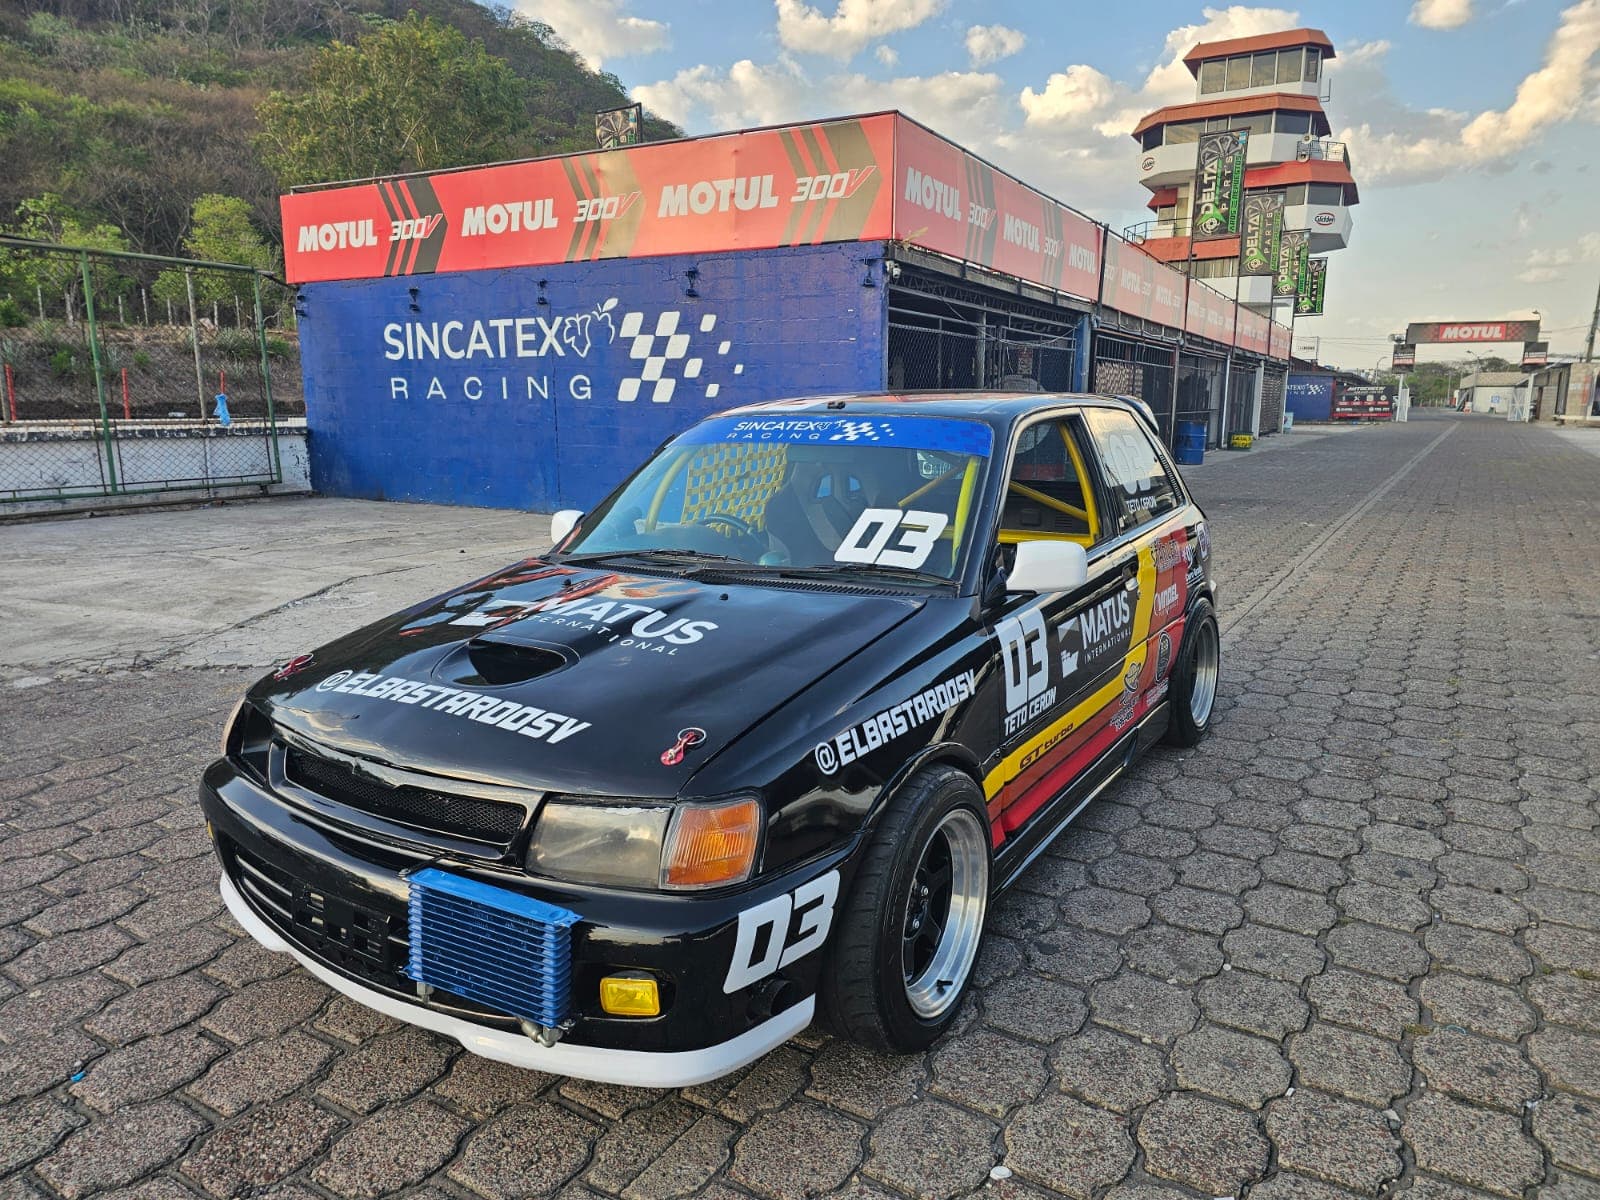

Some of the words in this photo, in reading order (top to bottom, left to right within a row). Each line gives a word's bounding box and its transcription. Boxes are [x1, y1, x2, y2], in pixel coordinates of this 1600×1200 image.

[297, 219, 378, 253] MOTUL
[389, 213, 443, 242] 300V
[461, 198, 558, 237] MOTUL
[574, 191, 641, 223] 300V
[657, 174, 779, 218] MOTUL
[790, 165, 877, 202] 300V
[1201, 159, 1218, 214] DELTA
[905, 166, 962, 222] MOTUL
[967, 202, 997, 231] 300V
[1003, 213, 1040, 253] MOTUL
[1069, 242, 1096, 274] MOTUL
[1246, 214, 1260, 256] DELTA
[383, 316, 565, 361] SINCATEX
[1442, 326, 1502, 339] MOTUL
[390, 375, 592, 400] RACING
[726, 432, 819, 441] RACING
[733, 420, 817, 431] SINCATEX
[834, 508, 948, 569] 03
[541, 598, 719, 645] MATUS
[1079, 590, 1131, 650] MATUS
[994, 607, 1048, 713] 03
[1084, 630, 1132, 665] INTERNATIONAL
[315, 669, 592, 744] @ELBASTARDOSV
[815, 668, 976, 775] @ELBASTARDOSV
[1004, 711, 1027, 737] TETO
[1028, 686, 1057, 720] CERON
[1020, 743, 1043, 769] GT
[1044, 723, 1073, 751] turbo
[722, 869, 840, 995] 03
